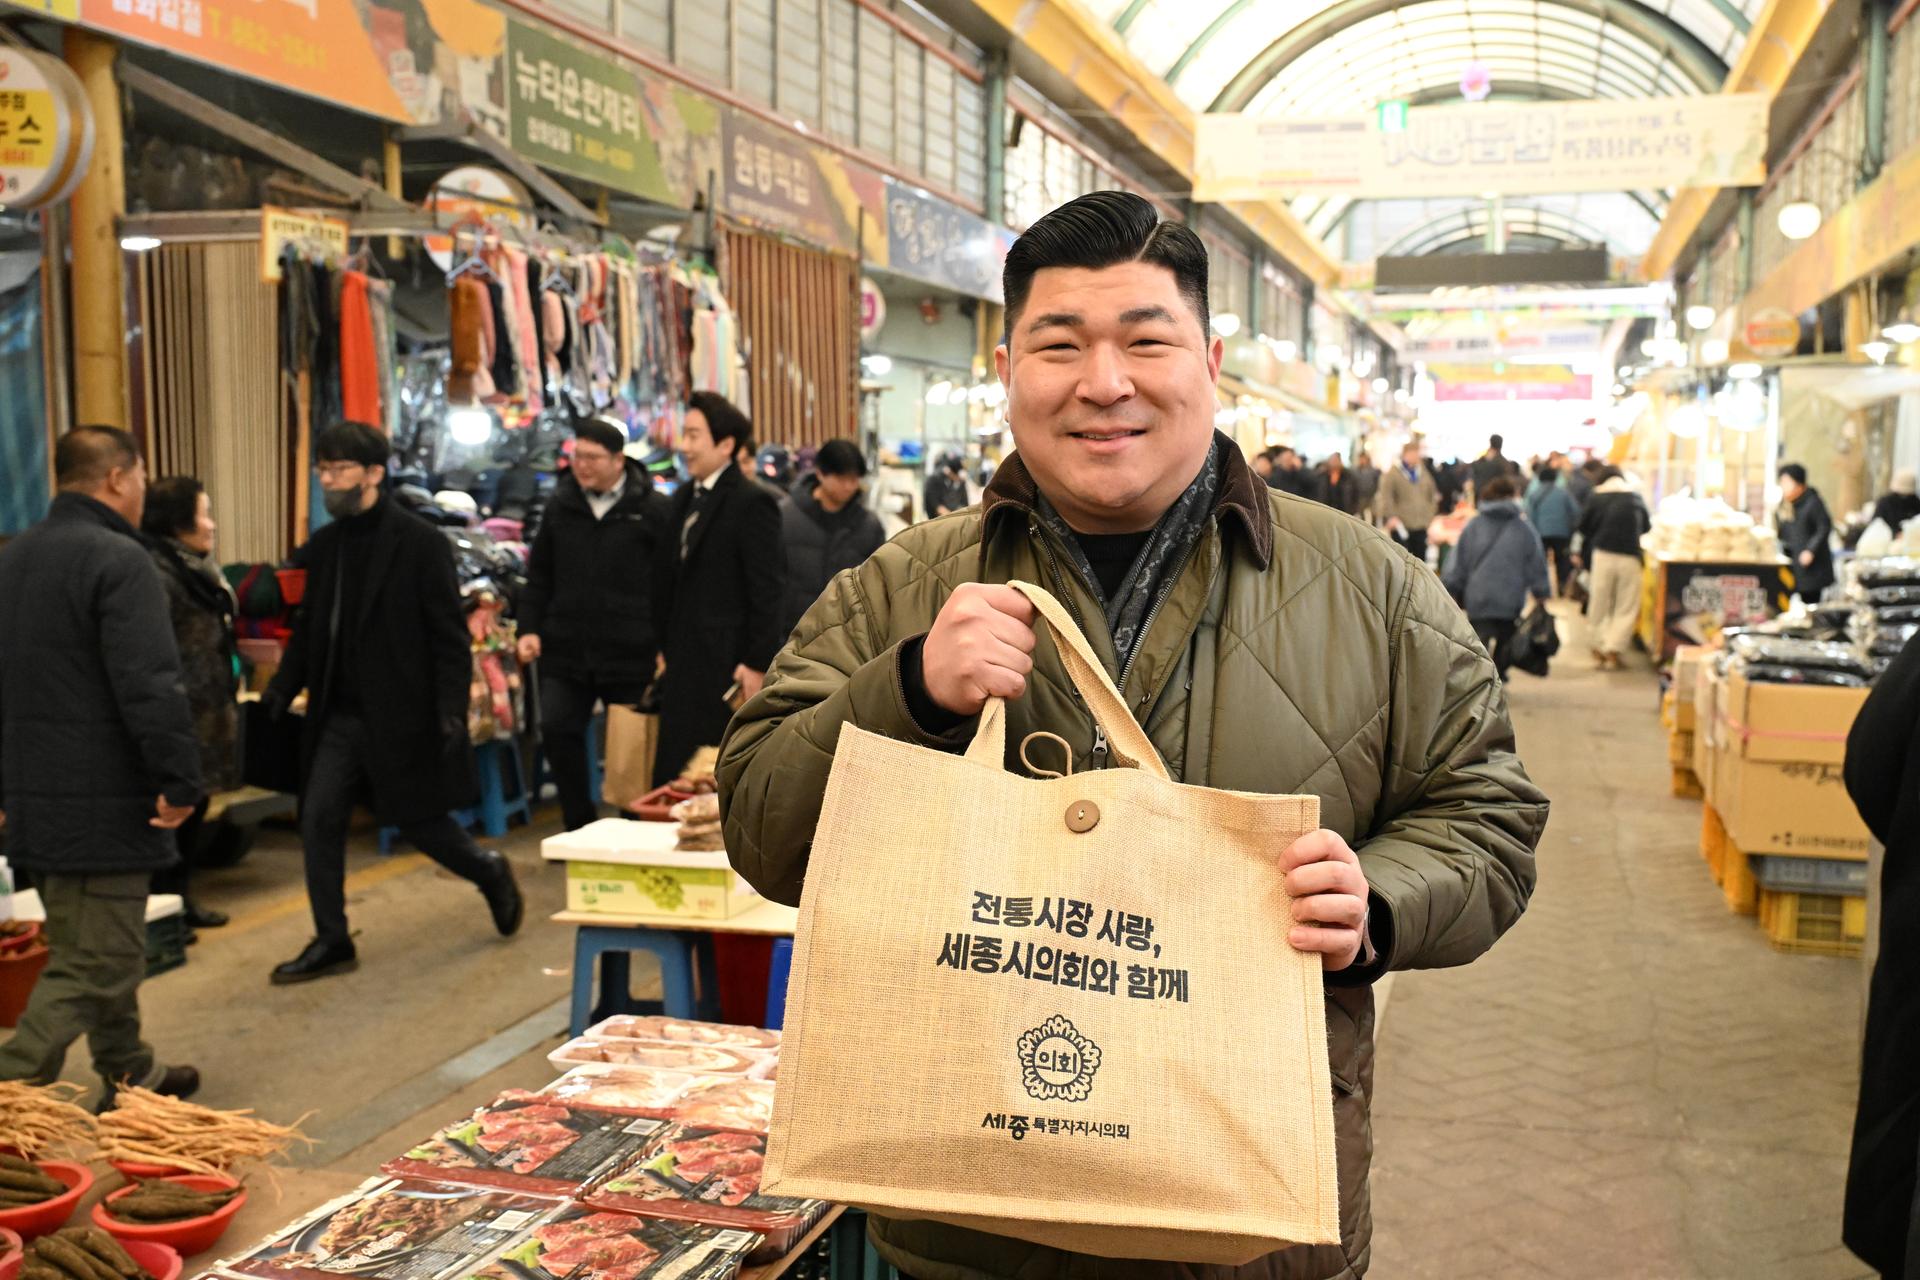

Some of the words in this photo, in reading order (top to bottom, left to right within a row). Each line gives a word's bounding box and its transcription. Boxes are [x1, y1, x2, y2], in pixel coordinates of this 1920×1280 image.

[515, 50, 641, 142] 뉴타운란제리
[971, 890, 1093, 938] 전통시장
[1096, 909, 1162, 959] 사랑,
[936, 932, 1120, 995] 세종시의회와
[1126, 963, 1189, 1003] 함께
[1036, 1050, 1078, 1074] 의회
